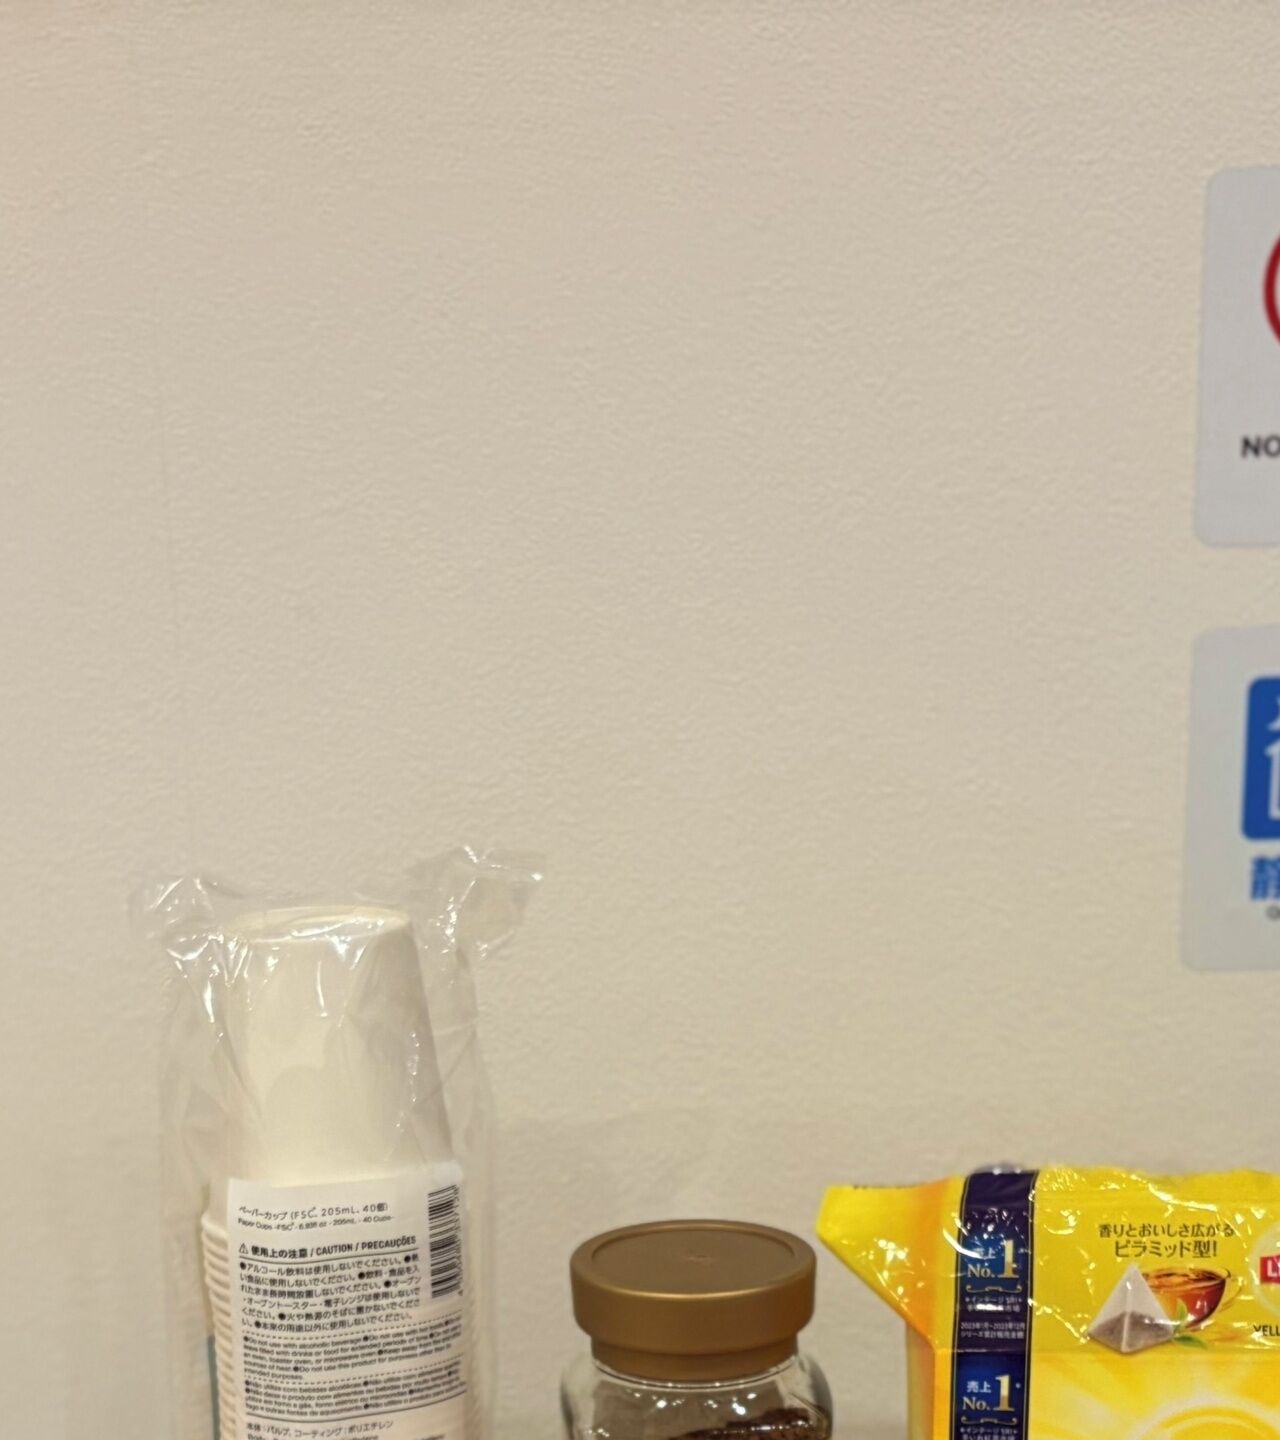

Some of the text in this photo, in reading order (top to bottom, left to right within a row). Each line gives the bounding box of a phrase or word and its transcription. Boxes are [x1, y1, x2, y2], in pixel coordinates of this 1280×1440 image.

[1098, 1222, 1235, 1239] 香りとおいしさ広がる
[251, 1235, 417, 1260] 使用上の注意 CAUTION PRECAUÇÕES
[1114, 1239, 1218, 1259] ピラミッド型!
[967, 1380, 992, 1393] 売上
